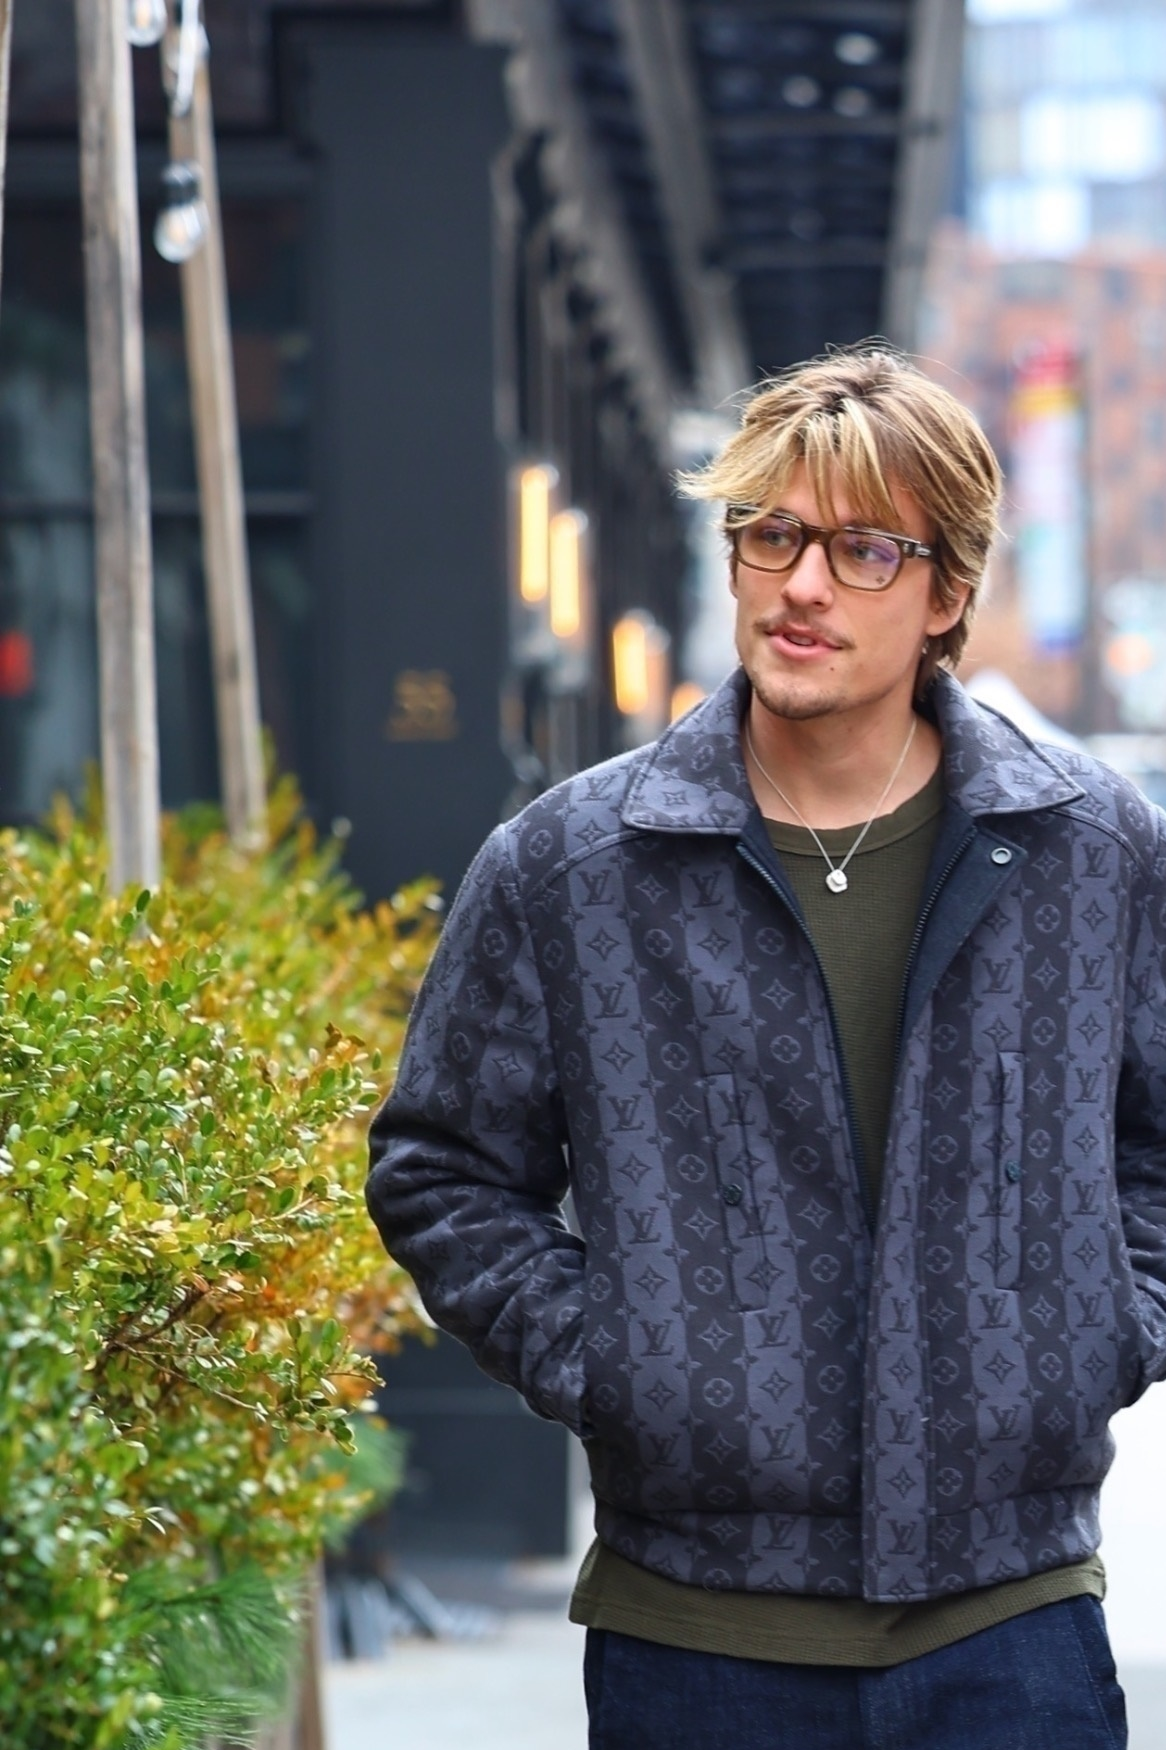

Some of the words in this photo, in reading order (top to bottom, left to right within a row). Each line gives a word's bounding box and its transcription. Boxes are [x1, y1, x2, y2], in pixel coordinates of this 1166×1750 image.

[577, 774, 618, 800] LV
[1081, 843, 1110, 878] LV
[578, 869, 615, 907] LV
[690, 869, 724, 907] LV
[984, 958, 1014, 994] LV
[1080, 954, 1106, 991] LV
[591, 981, 628, 1019] LV
[703, 979, 739, 1016] LV
[1075, 1067, 1102, 1103] LV
[608, 1094, 645, 1131] LV
[1072, 1180, 1101, 1215] LV
[625, 1208, 661, 1244] LV
[980, 1293, 1011, 1329] LV
[1075, 1292, 1104, 1328] LV
[639, 1319, 674, 1356] LV
[756, 1311, 789, 1348] LV
[987, 1405, 1021, 1441] LV
[646, 1432, 680, 1467] LV
[762, 1423, 795, 1463] LV
[887, 1519, 917, 1554] LV
